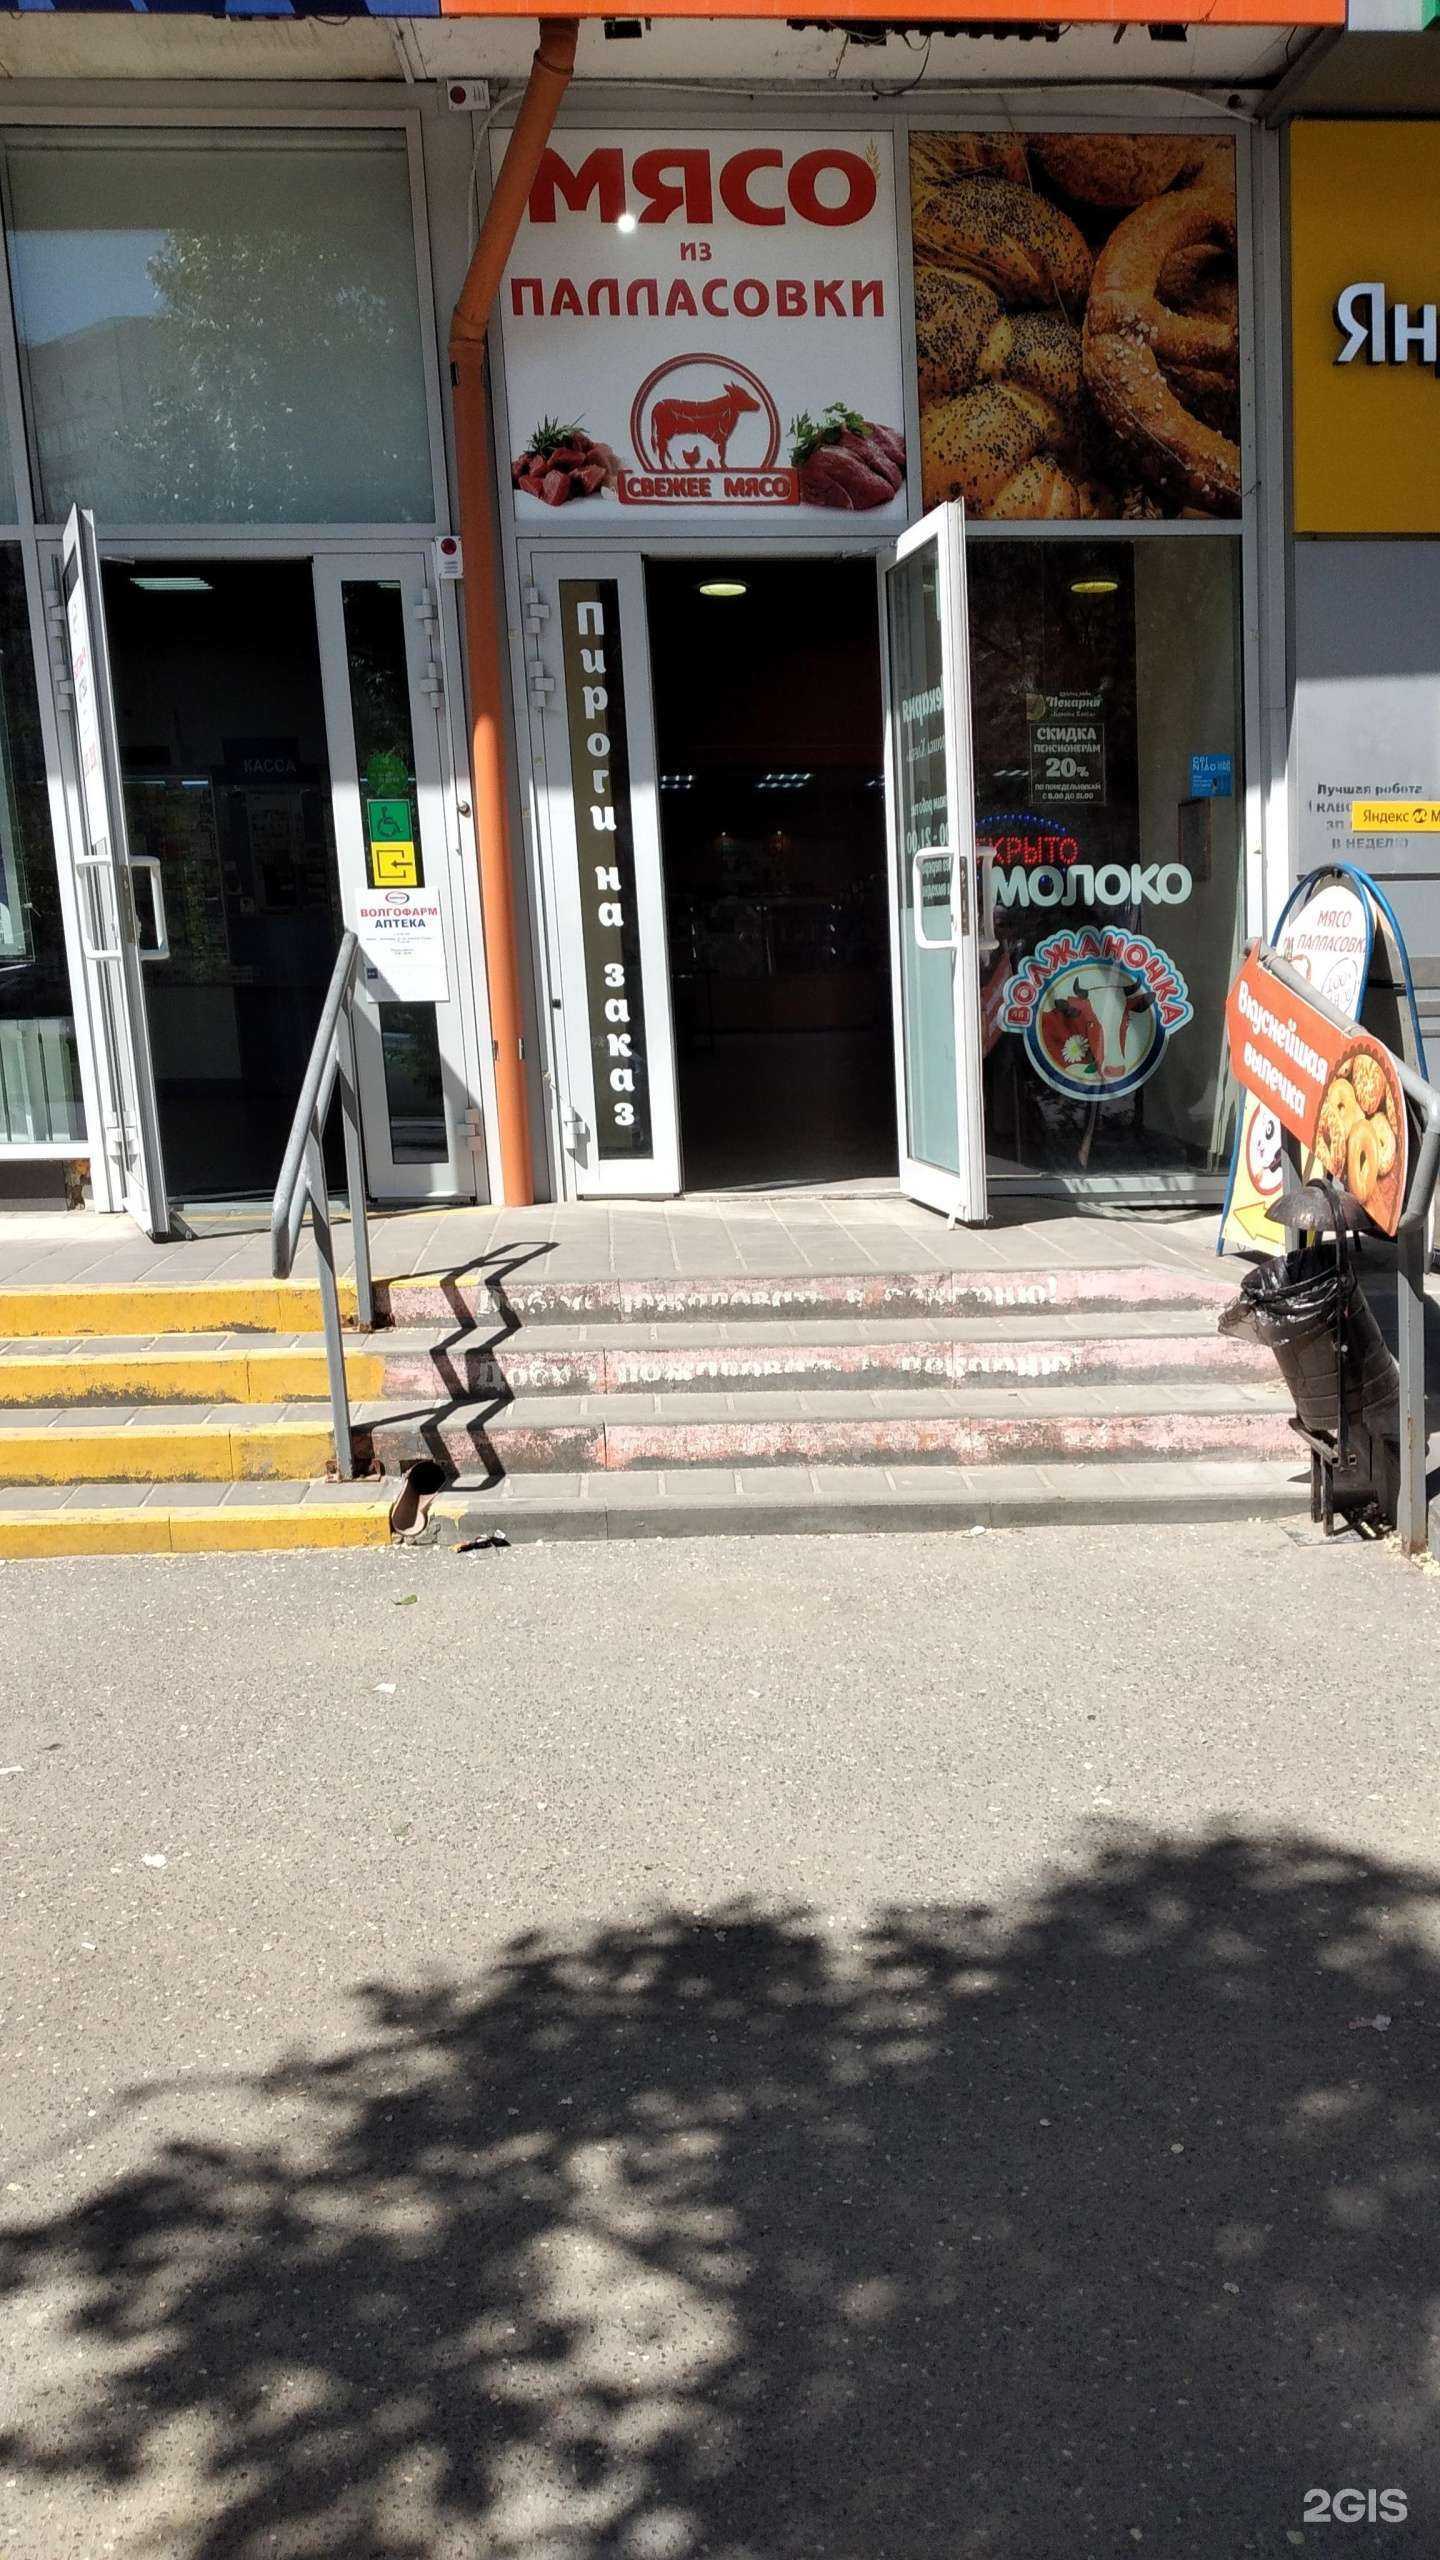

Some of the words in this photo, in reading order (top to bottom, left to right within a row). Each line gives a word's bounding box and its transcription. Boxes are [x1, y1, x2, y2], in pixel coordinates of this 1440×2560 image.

[528, 147, 877, 227] МЯСО
[510, 277, 885, 318] ПАЛЛАСОВКИ
[1337, 282, 1437, 362] Ян
[626, 476, 712, 497] СВЕЖЕЕ
[723, 476, 791, 497] МЯСО
[576, 601, 618, 832] Пироги
[1036, 727, 1097, 742] СКИДКА
[242, 758, 297, 773] КАССА
[1033, 744, 1101, 753] ПЕНСИОНЕРАМ
[1045, 757, 1090, 778] 20%
[1363, 808, 1410, 824] Яндекс
[594, 865, 625, 928] на
[992, 862, 1193, 908] МОЛОКО
[360, 907, 438, 918] ВОЛГОФАРМ
[375, 918, 427, 929] АПТЕКА
[1316, 911, 1352, 929] МЯСО
[1006, 933, 1186, 1026] ВОЛЖАНОЧКА
[603, 962, 636, 1127] заказ
[1238, 979, 1329, 1086] Вкуснейшая
[1243, 1040, 1307, 1119] выпечка
